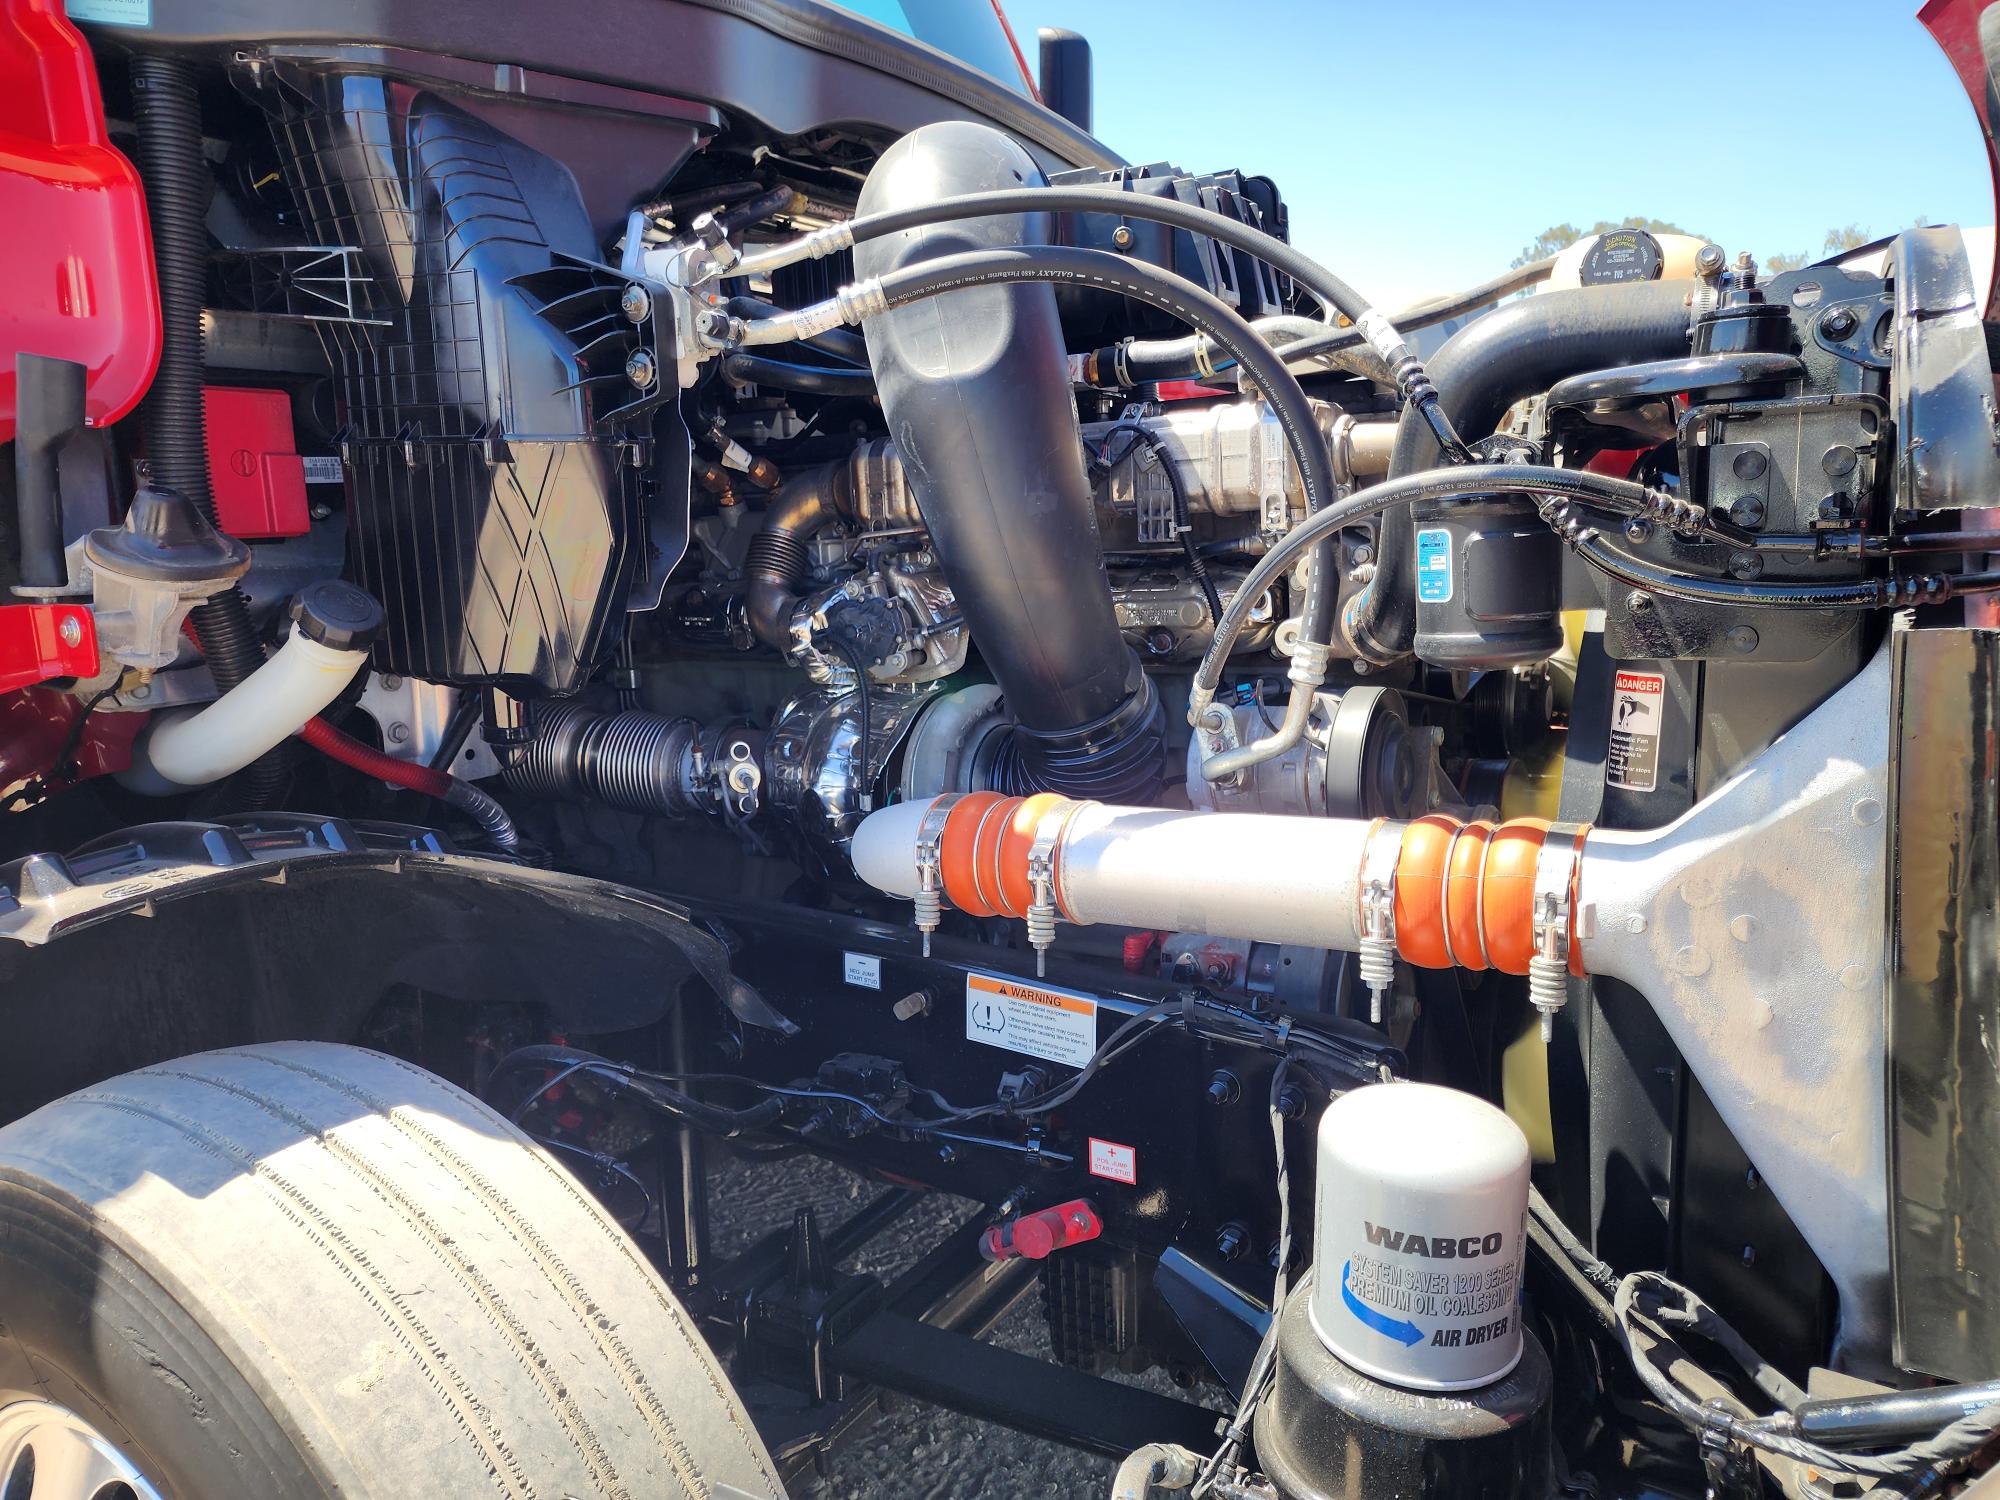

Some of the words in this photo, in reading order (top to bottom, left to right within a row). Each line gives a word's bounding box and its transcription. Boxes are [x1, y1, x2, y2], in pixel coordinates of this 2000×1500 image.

[1231, 344, 1244, 359] HOSE
[1244, 357, 1263, 378] SUCTION
[1306, 476, 1318, 512] GALAXY
[1623, 678, 1660, 692] DANGER
[1010, 987, 1061, 1006] WARNING
[1029, 1004, 1045, 1013] original
[1047, 1009, 1071, 1018] equipment
[1038, 1030, 1055, 1039] causing
[1095, 1164, 1113, 1172] START
[1364, 1221, 1502, 1259] WABCO
[1351, 1251, 1401, 1288] SYSTEM
[1404, 1268, 1448, 1294] SAVER
[1453, 1272, 1482, 1293] 1200
[1484, 1261, 1515, 1289] SERIES
[1350, 1271, 1410, 1313] PREMIUM
[1414, 1295, 1438, 1316] OIL
[1441, 1284, 1512, 1316] COALESCING
[1431, 1329, 1461, 1346] AIR
[1465, 1317, 1508, 1346] DRYER
